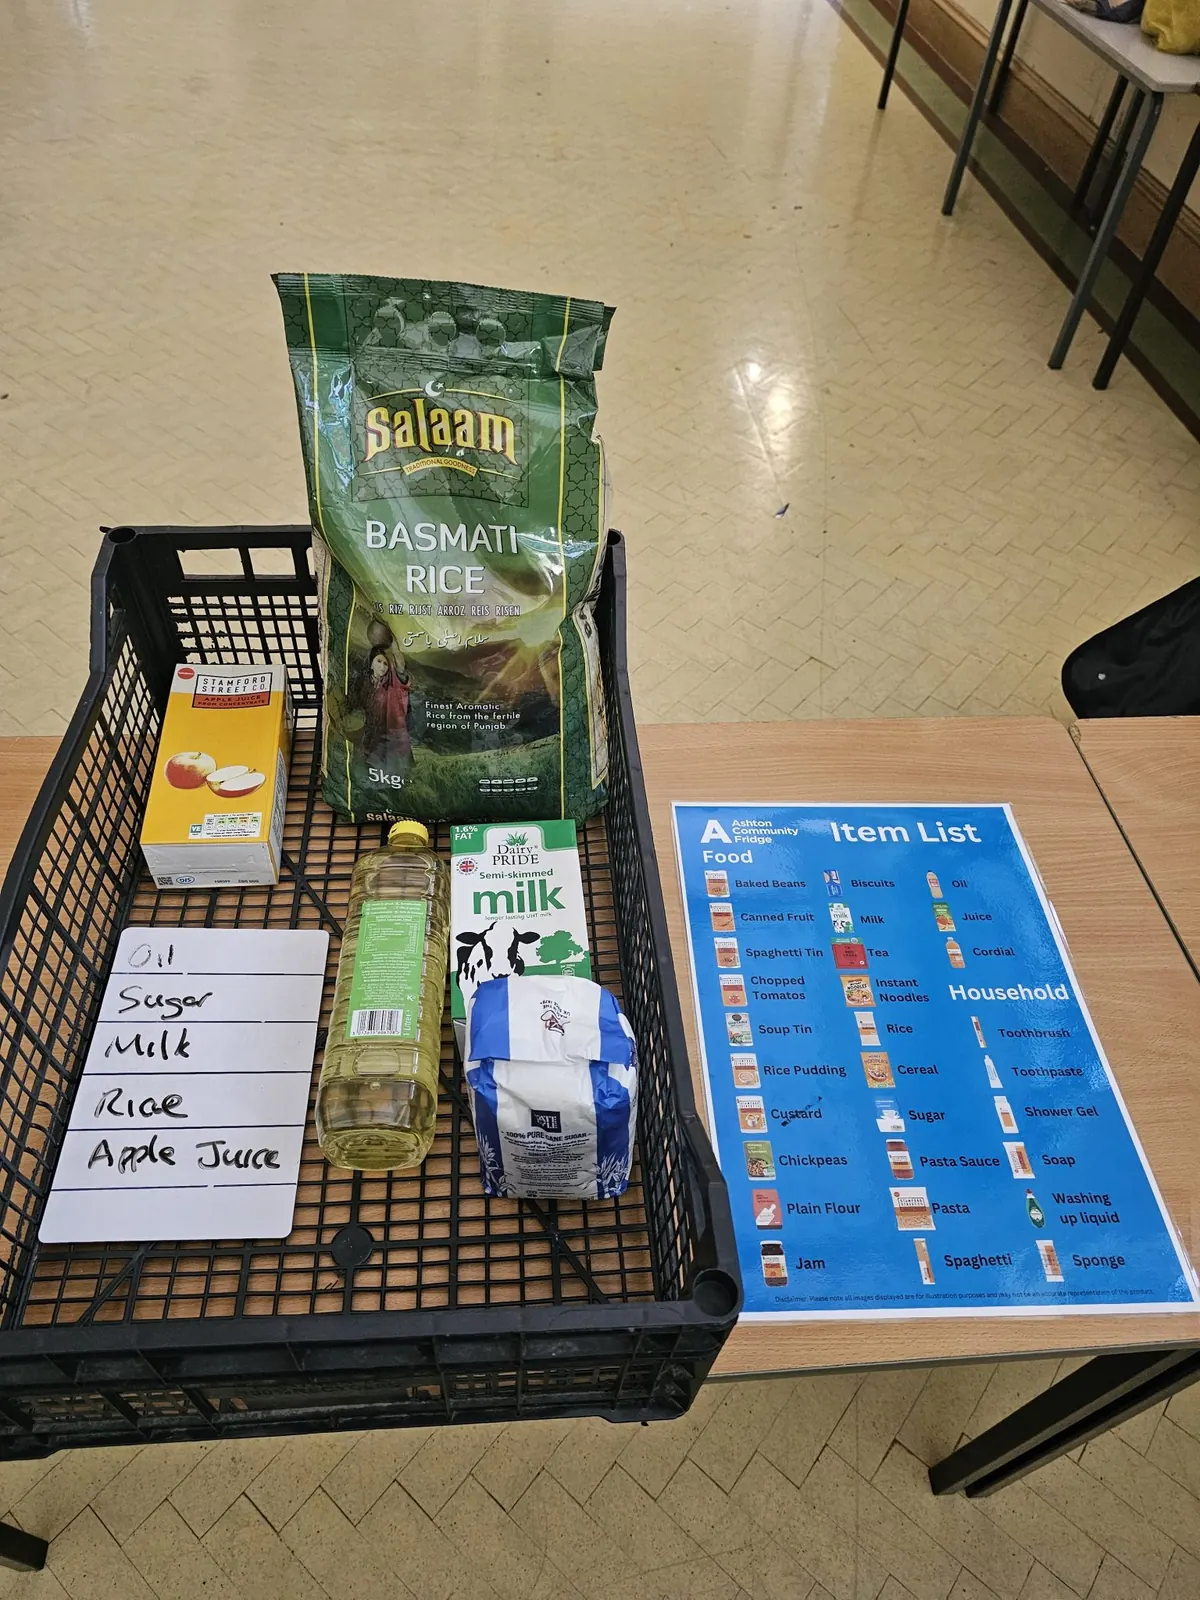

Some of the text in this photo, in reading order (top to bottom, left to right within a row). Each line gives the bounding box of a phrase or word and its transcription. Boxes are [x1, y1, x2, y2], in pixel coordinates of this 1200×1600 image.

[361, 398, 519, 467] Salaam
[405, 458, 476, 474] TRADITIONAL GOODNESS
[365, 519, 519, 554] BASMATI
[405, 564, 485, 594] RICE
[389, 604, 404, 615] RIZ
[408, 604, 432, 616] RIJST
[437, 605, 466, 616] ARROZ
[471, 604, 490, 616] REIS
[495, 605, 521, 616] RISEN
[203, 676, 266, 686] STAMFORD
[425, 701, 500, 711] Finest Aromatic
[426, 711, 521, 720] Rice from the fertile
[426, 721, 458, 731] region
[460, 720, 472, 730] of
[454, 825, 478, 833] 1.6%
[732, 819, 773, 827] Ashton
[454, 832, 474, 840] FAT
[732, 827, 799, 836] Community
[830, 821, 982, 843] Item List
[734, 835, 773, 845] Fridge
[496, 844, 533, 856] Dairy
[492, 854, 540, 866] PRIDE
[702, 850, 753, 864] Food
[479, 868, 554, 880] Semi-skimmed
[735, 879, 806, 888] Baked Beans
[851, 879, 896, 888] Biscuits
[952, 879, 968, 889] Oil
[472, 879, 566, 915] milk
[505, 914, 525, 922] lasting
[740, 912, 815, 922] Canned Fruit
[860, 915, 885, 924] Milk
[962, 912, 993, 922] Juice
[127, 943, 174, 968] Oil
[745, 947, 824, 960] Spaghetti Tin
[867, 948, 889, 957] Tea
[972, 947, 1016, 957] Cordial
[750, 975, 806, 987] Chopped
[875, 978, 918, 988] Instant
[752, 991, 806, 1000] Tomatos
[879, 992, 930, 1002] Noodles
[948, 983, 1070, 1001] Household
[118, 985, 214, 1020] Sugar
[758, 1024, 790, 1036] Soup
[792, 1024, 813, 1034] Tin
[886, 1023, 914, 1034] Rice
[998, 1028, 1071, 1038] Toothbrush
[104, 1027, 190, 1060] Milk
[763, 1065, 847, 1078] Rice Pudding
[897, 1065, 939, 1075] Cereal
[1011, 1066, 1084, 1079] Toothpaste
[770, 1108, 823, 1120] Custard
[908, 1110, 946, 1123] Sugar
[1024, 1106, 1100, 1118] Shower Gel
[506, 1131, 526, 1140] 100%
[527, 1131, 545, 1139] PURE
[545, 1134, 563, 1142] CANE
[564, 1132, 588, 1140] SUGAR
[87, 1134, 281, 1175] Apple Juice
[1041, 1154, 1076, 1167] Soap
[778, 1154, 849, 1168] Chickpeas
[920, 1156, 1000, 1167] Pasta Sauce
[1051, 1192, 1113, 1206] Washing
[787, 1202, 861, 1215] Plain Flour
[931, 1202, 971, 1215] Pasta
[1059, 1211, 1120, 1226] up liquid
[795, 1257, 826, 1270] Jam
[944, 1253, 1012, 1270] Spaghetti
[1071, 1254, 1126, 1269] Sponge
[874, 1293, 904, 1301] displayed
[958, 1292, 986, 1300] purposes
